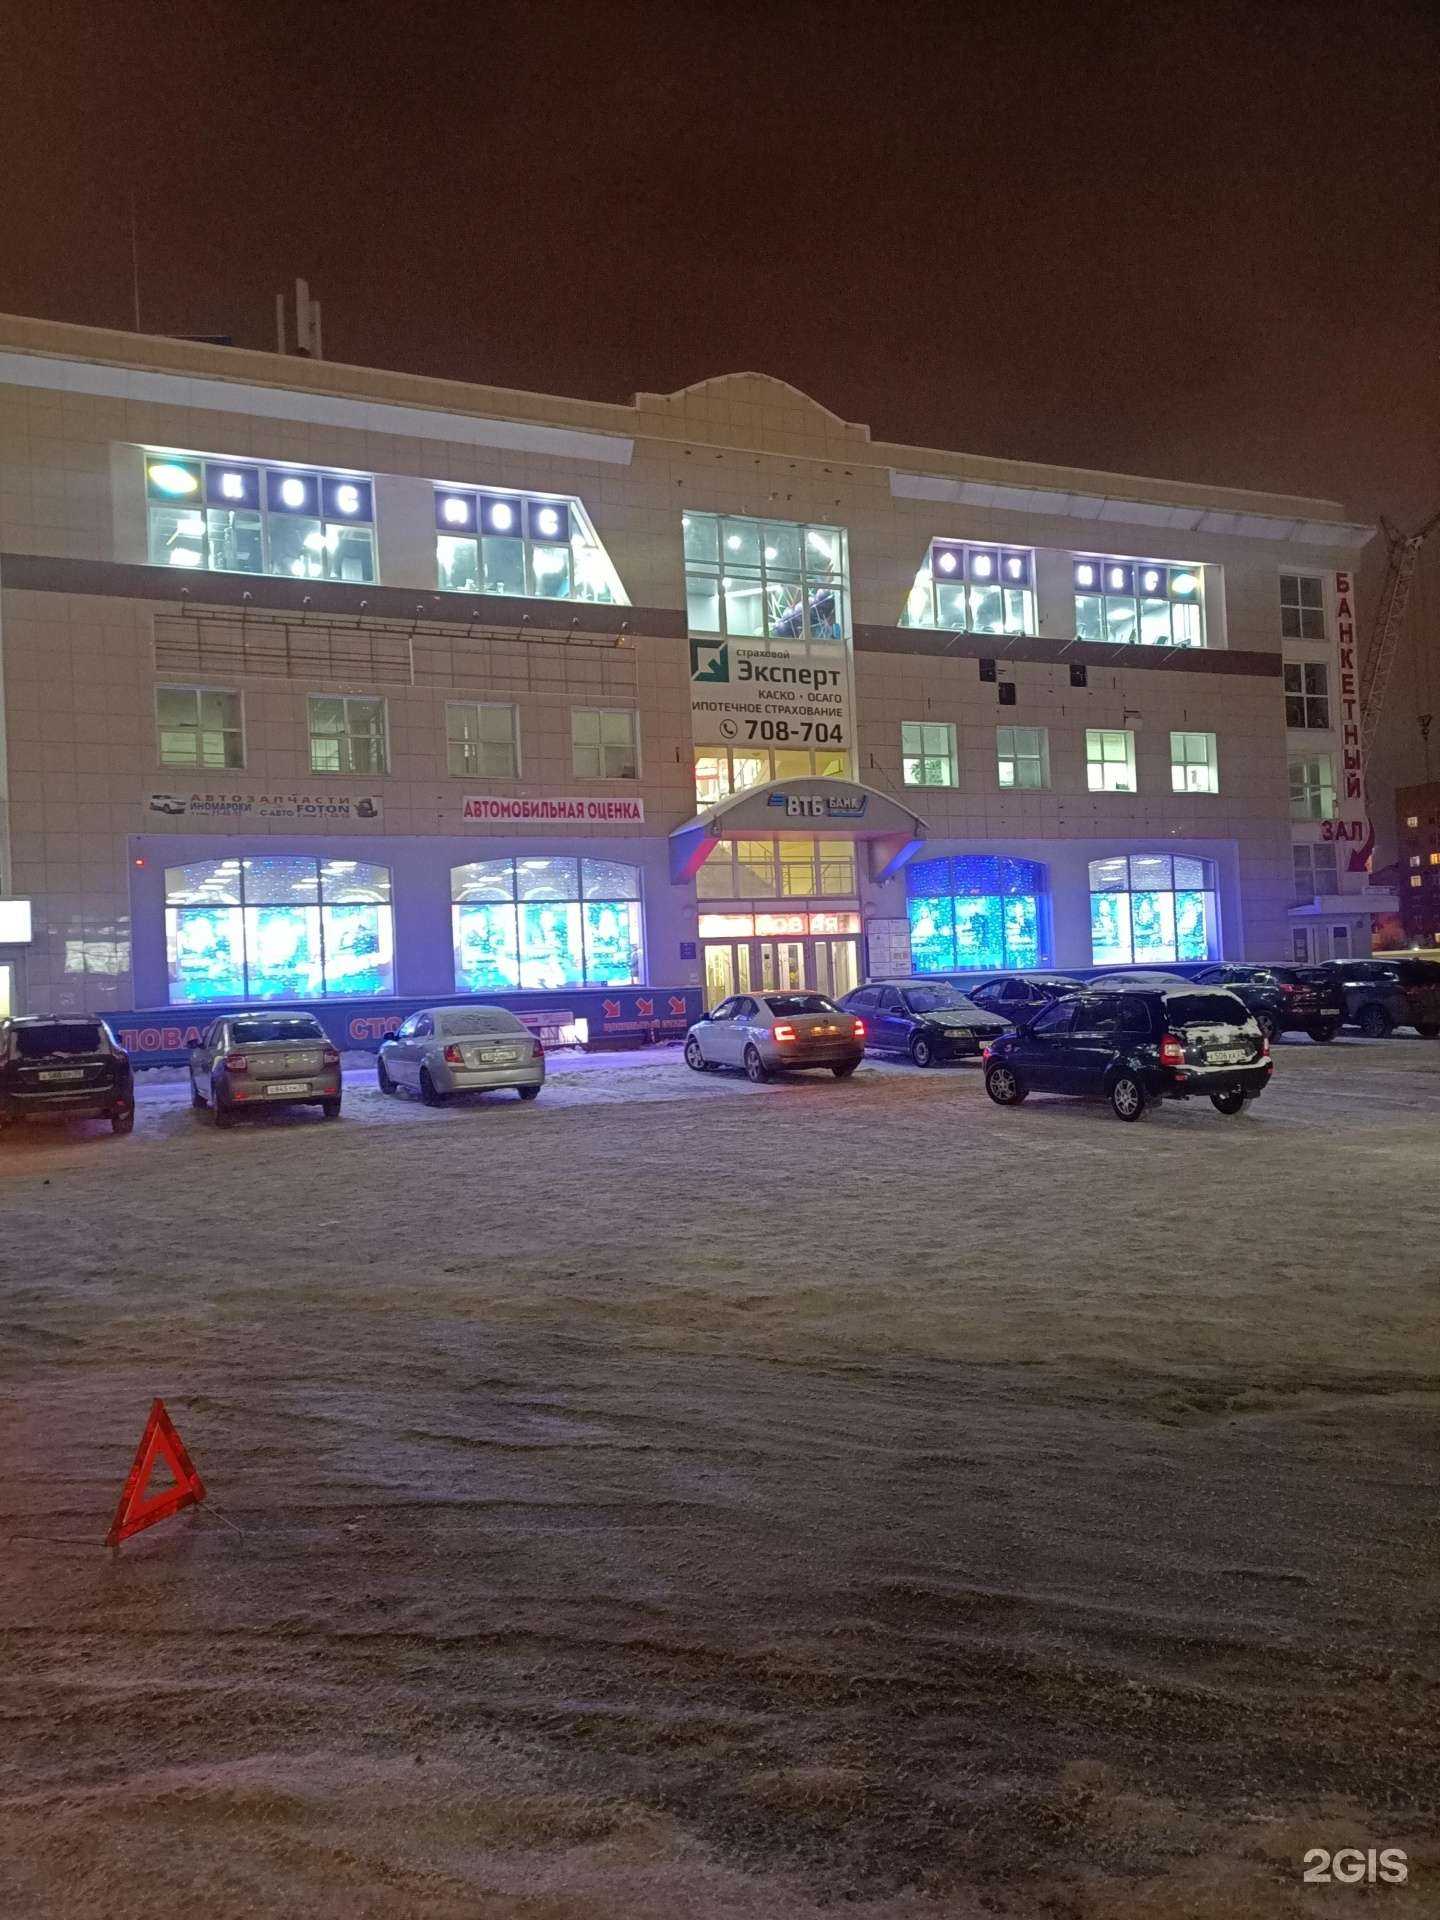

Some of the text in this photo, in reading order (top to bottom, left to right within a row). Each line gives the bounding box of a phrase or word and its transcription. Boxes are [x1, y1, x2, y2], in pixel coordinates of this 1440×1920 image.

[736, 649, 790, 660] страховой
[737, 659, 841, 690] Эксперт
[1335, 572, 1361, 798] БАНКЕТНЫЙ
[758, 689, 842, 704] КАСКО ОСАГО
[692, 701, 843, 717] ИПОТЕЧНОЕ СТРАХОВАНИЕ
[744, 719, 843, 743] 708-704
[191, 793, 350, 805] АВТОЗАПЧАСТИ
[297, 803, 350, 814] FOTON
[786, 795, 859, 817] ВТБ БАНК
[463, 800, 641, 820] АВТОМОБИЛЬНАЯ ОЦЕНКА
[1320, 819, 1364, 841] ЗАЛ
